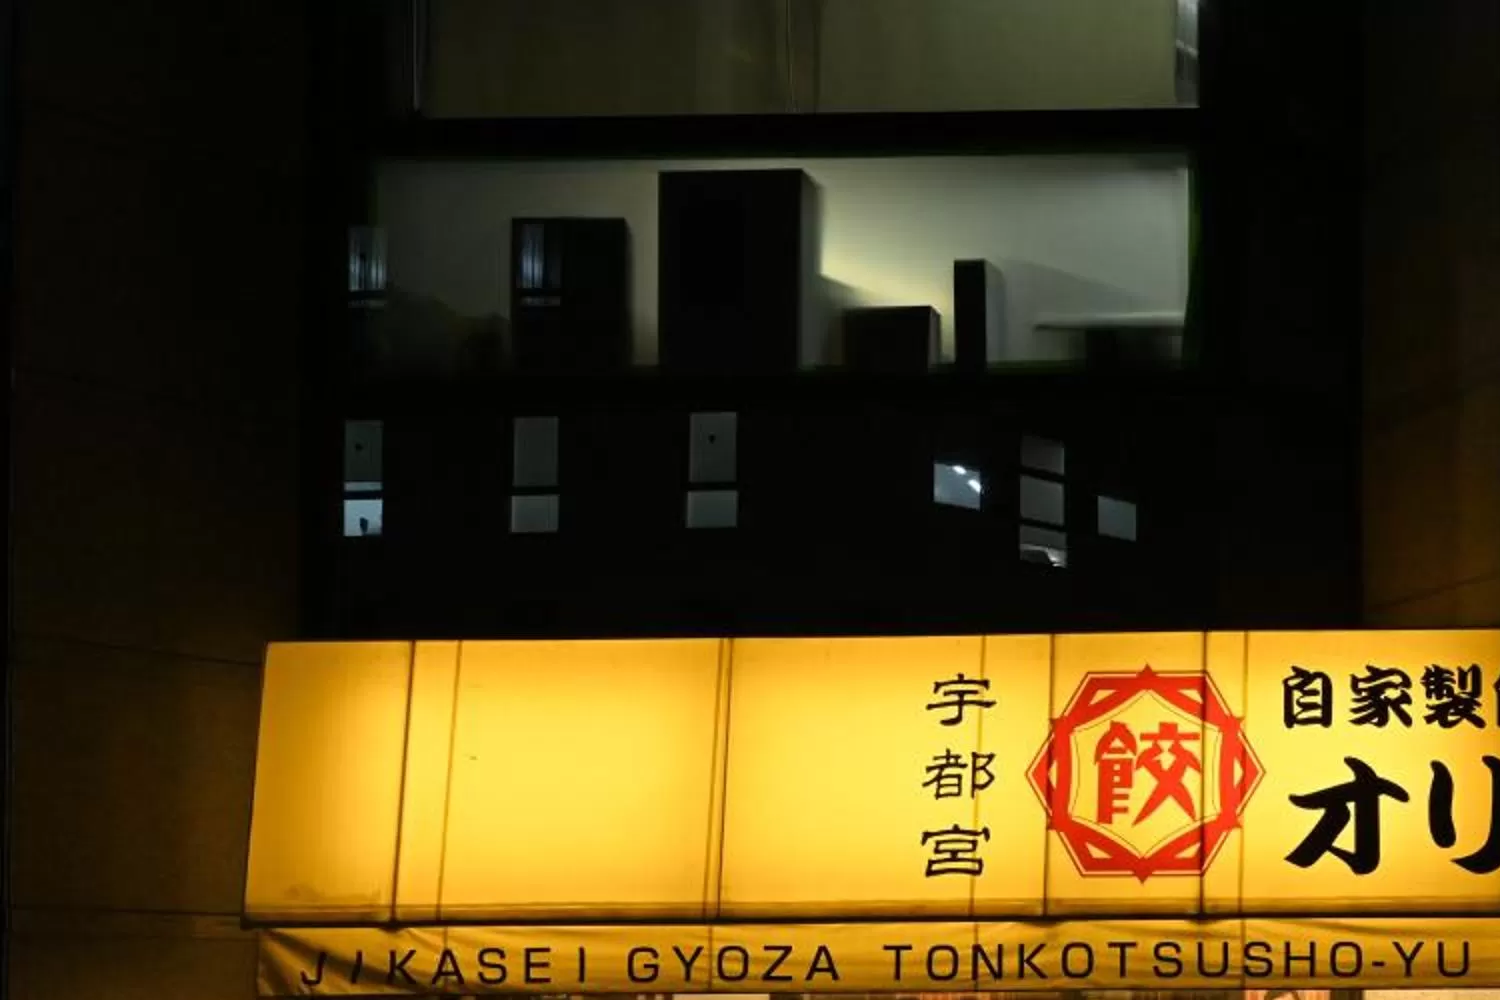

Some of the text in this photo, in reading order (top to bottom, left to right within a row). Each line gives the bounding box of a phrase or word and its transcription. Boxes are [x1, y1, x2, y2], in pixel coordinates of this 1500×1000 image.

[921, 673, 997, 877] 宇都宮
[1095, 720, 1203, 826] 餃
[301, 946, 586, 986] JIKASEI
[627, 943, 841, 984] GYOZA
[884, 940, 1470, 980] TONKOTSUSHO-YU
